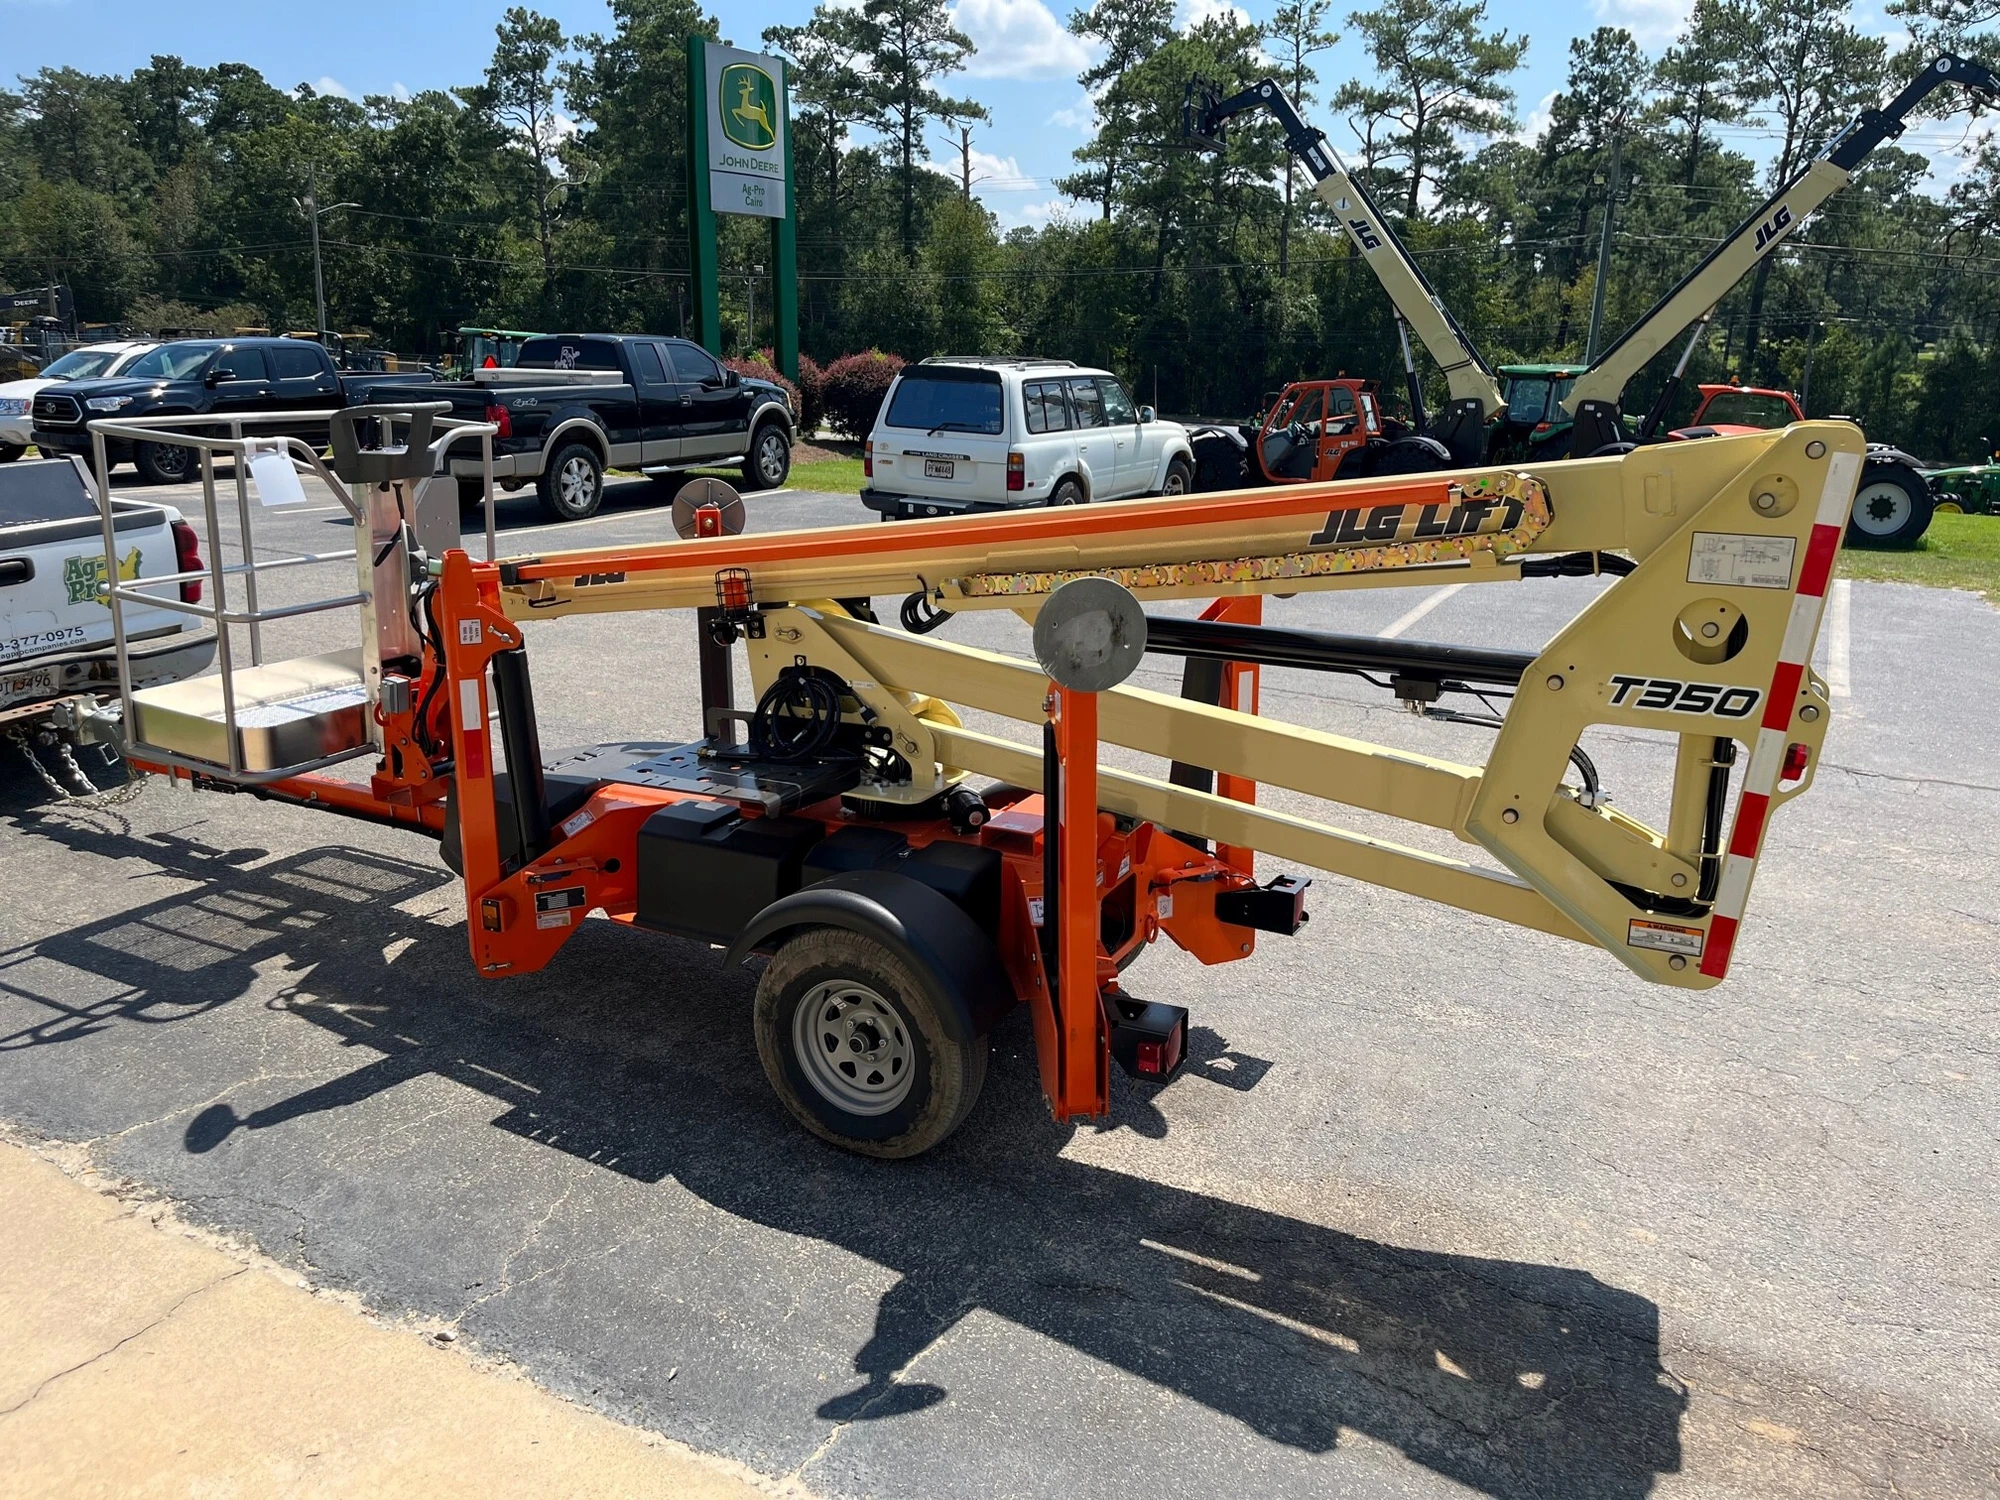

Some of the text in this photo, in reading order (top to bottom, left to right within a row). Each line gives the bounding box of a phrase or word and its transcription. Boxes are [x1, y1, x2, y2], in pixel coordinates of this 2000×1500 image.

[719, 153, 779, 174] JOHN DEERE
[742, 183, 766, 196] Ag-Pro
[745, 195, 764, 207] Cairo
[1348, 219, 1382, 250] JLG
[1754, 203, 1792, 252] JLG
[1310, 496, 1525, 545] JLG LIFT
[67, 558, 105, 582] Ag-
[1608, 675, 1762, 719] T350
[1652, 922, 1687, 934] WARNING
